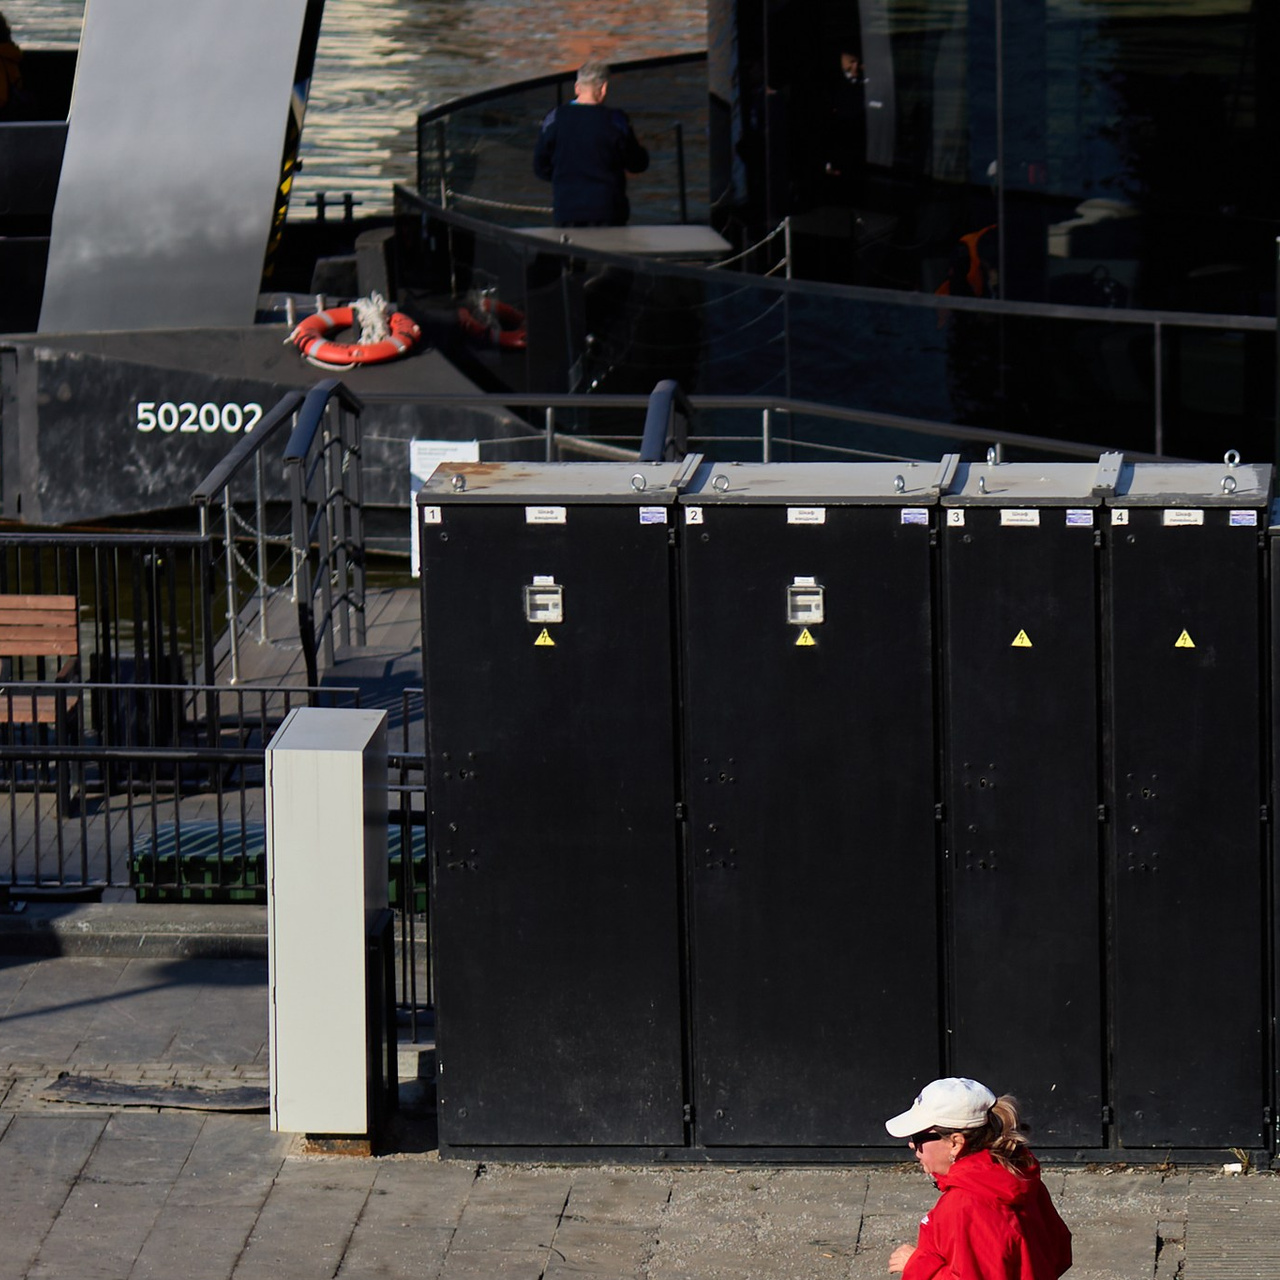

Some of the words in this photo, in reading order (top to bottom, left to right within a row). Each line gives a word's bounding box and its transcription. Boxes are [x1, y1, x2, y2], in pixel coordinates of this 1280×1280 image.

[137, 402, 262, 433] 502002
[690, 510, 698, 521] 2
[952, 511, 960, 523] 3
[1116, 512, 1124, 523] 4
